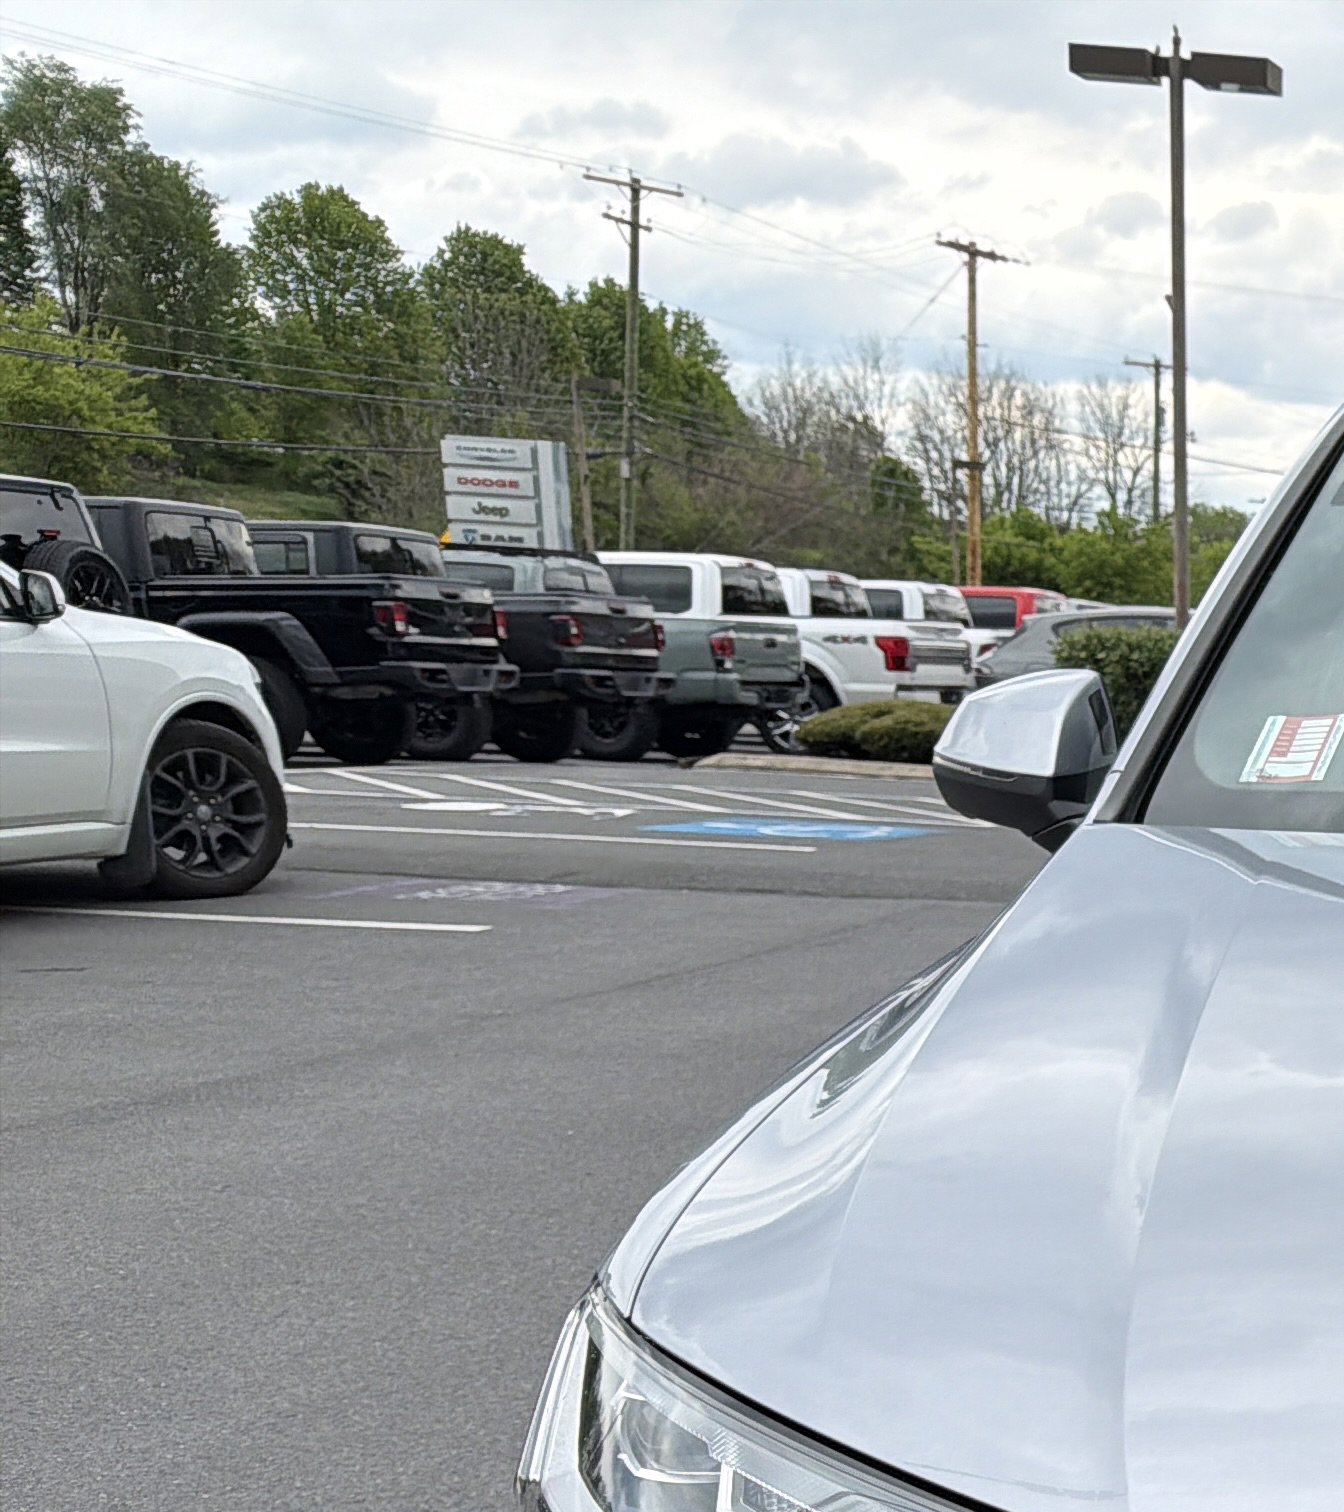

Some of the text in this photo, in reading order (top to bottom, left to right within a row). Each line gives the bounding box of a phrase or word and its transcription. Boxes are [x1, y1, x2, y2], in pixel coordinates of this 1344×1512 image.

[456, 476, 520, 489] DODGE
[471, 501, 510, 518] Jeep
[480, 532, 525, 544] RAM
